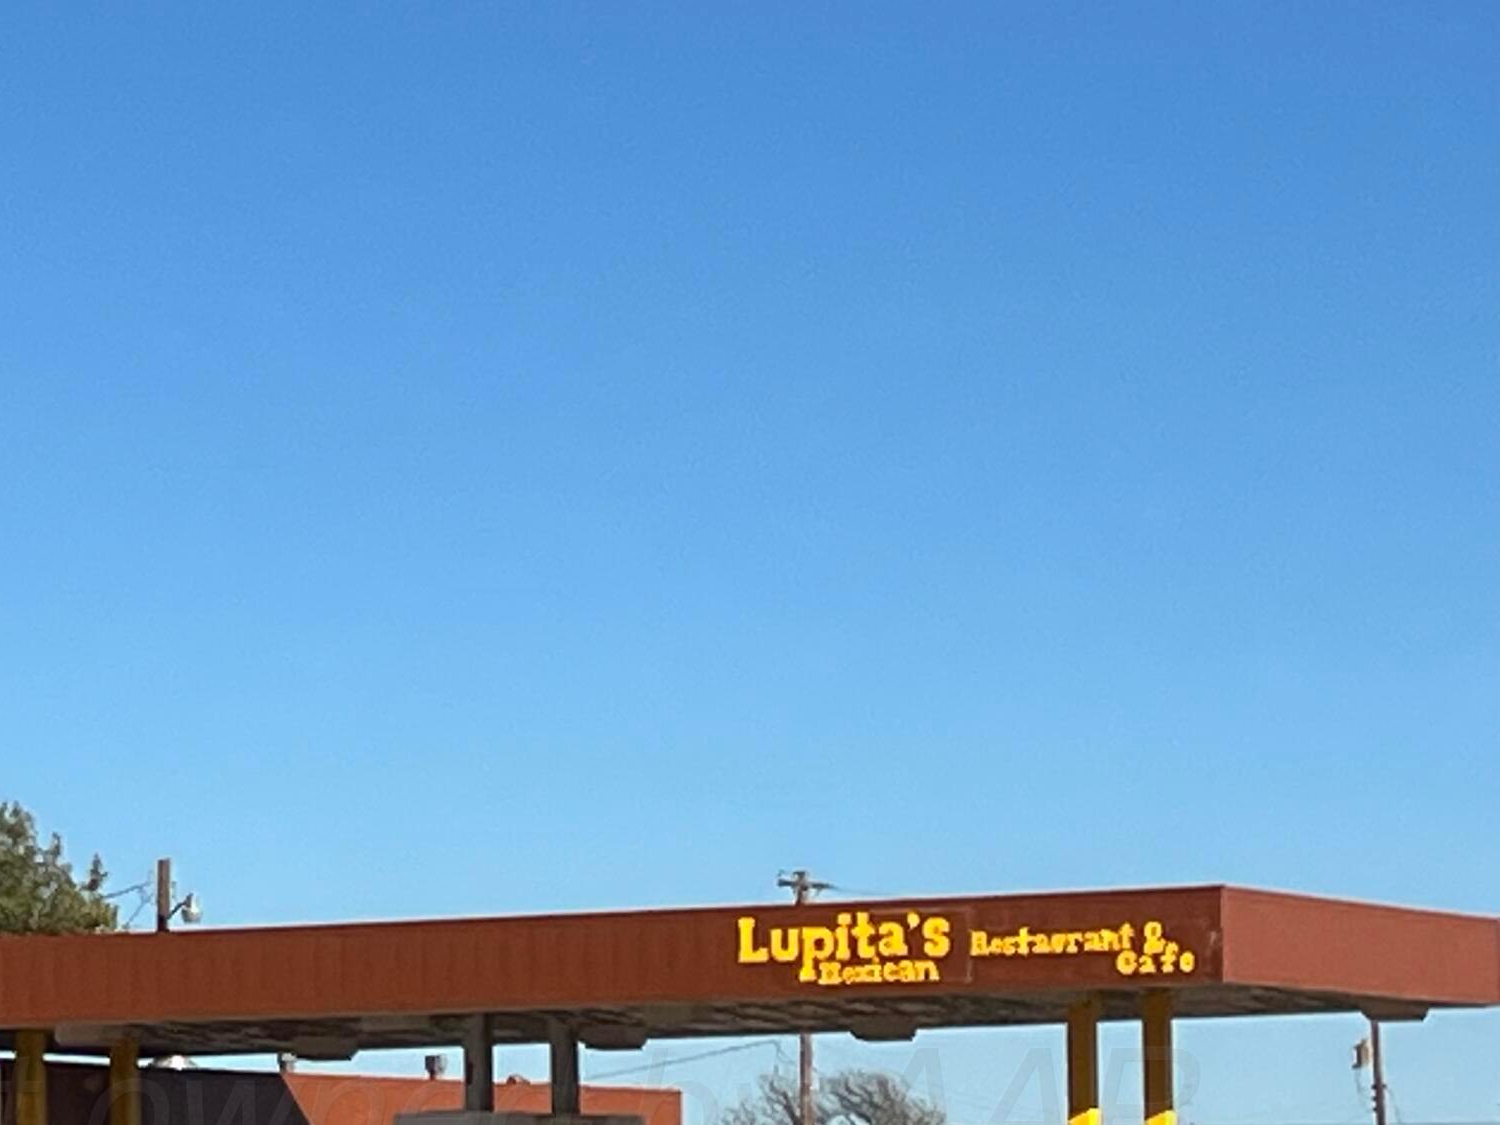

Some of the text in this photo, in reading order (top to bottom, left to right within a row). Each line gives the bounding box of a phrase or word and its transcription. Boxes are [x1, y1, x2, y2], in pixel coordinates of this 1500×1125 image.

[738, 911, 950, 981] Lupita's
[970, 922, 1134, 957] Restaurant
[817, 957, 940, 985] Mexican
